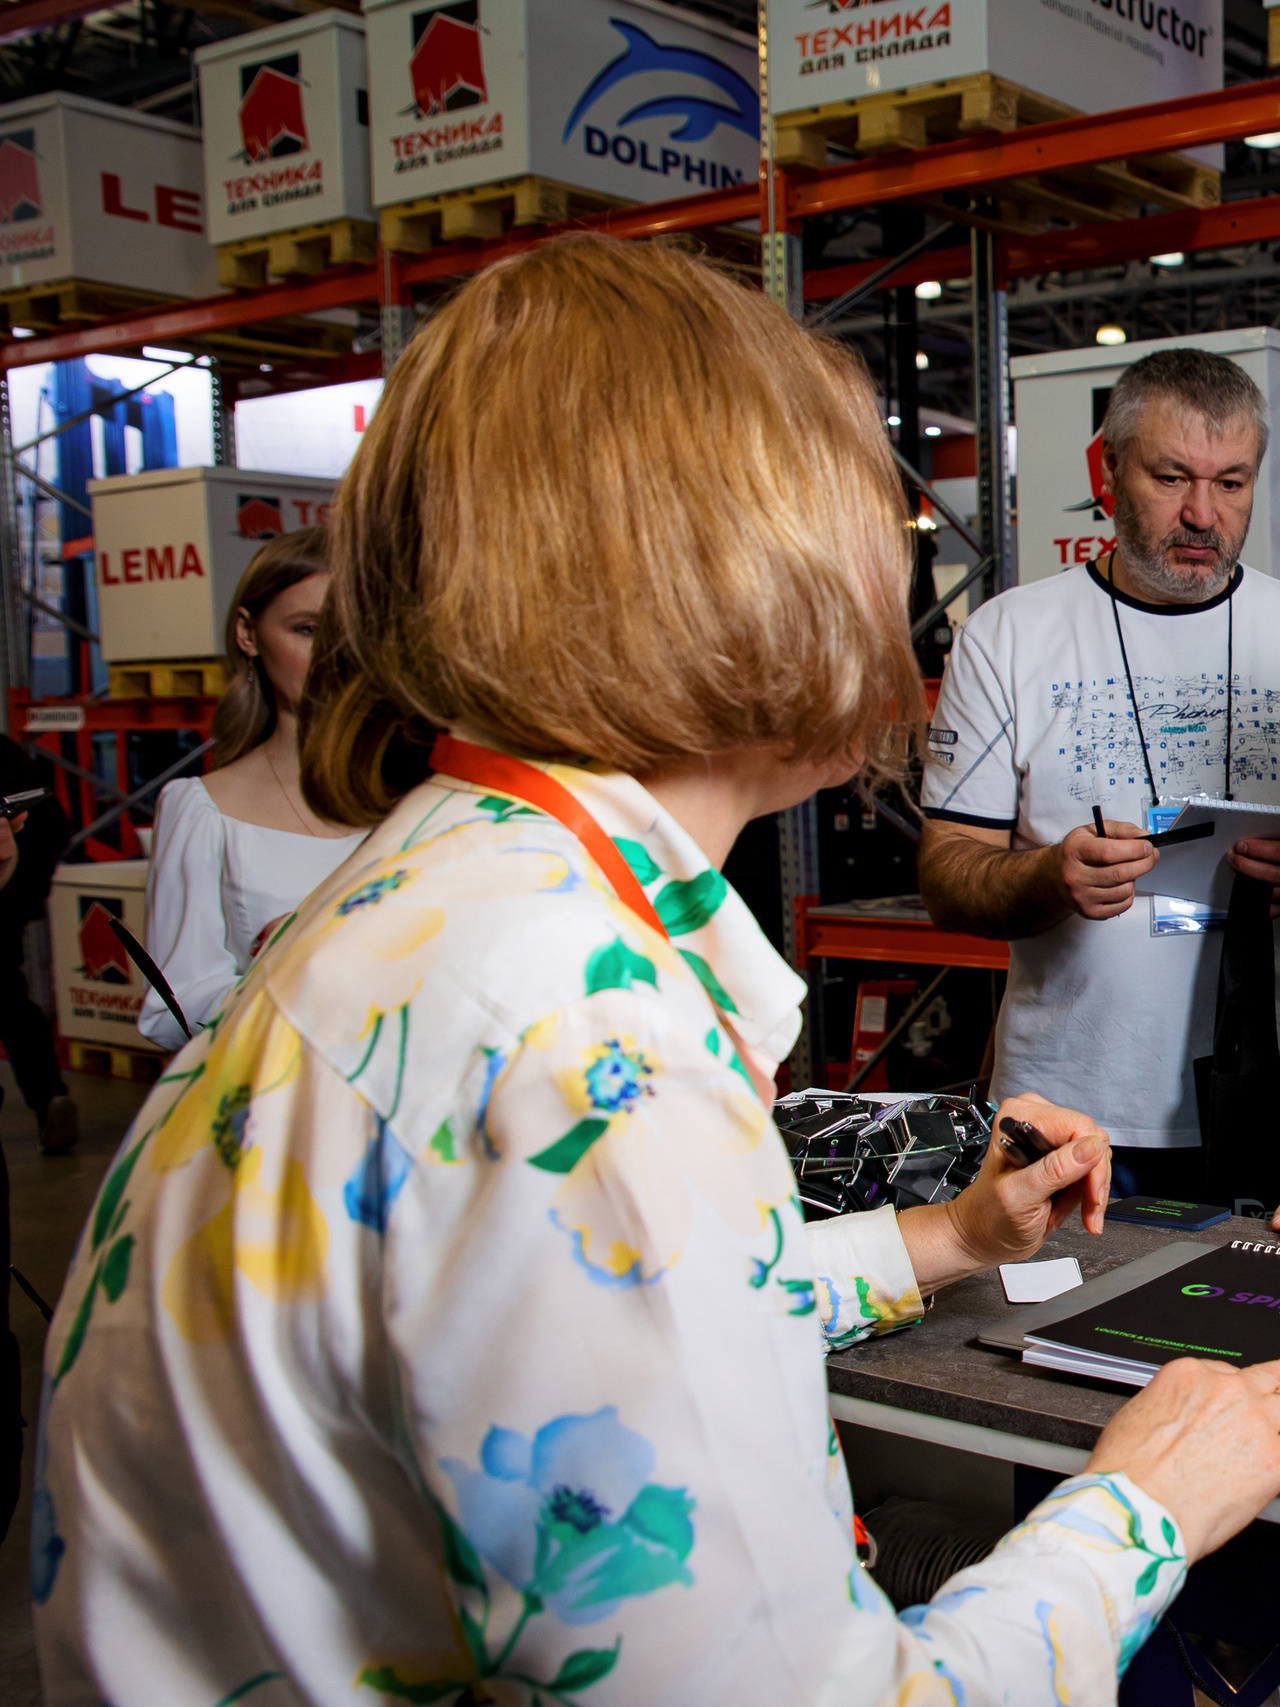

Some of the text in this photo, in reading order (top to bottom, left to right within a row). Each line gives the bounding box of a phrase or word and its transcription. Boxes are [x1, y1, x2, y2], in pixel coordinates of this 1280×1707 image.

[795, 2, 951, 59] ТЕХНИКА
[799, 31, 951, 75] ДЛЯ СКЛАДА
[390, 111, 503, 158] ТЕХНИКА
[584, 124, 744, 190] DOLPHIN
[223, 160, 323, 200] ТЕХНИКА
[101, 171, 204, 234] LE
[291, 500, 331, 526] ТЕ
[101, 543, 204, 586] LEMA
[1054, 538, 1116, 564] ТЕХ
[1094, 1326, 1136, 1339] LOGISTICS
[1144, 1336, 1185, 1348] CUSTOMS
[1185, 1344, 1243, 1357] FORWARDER
